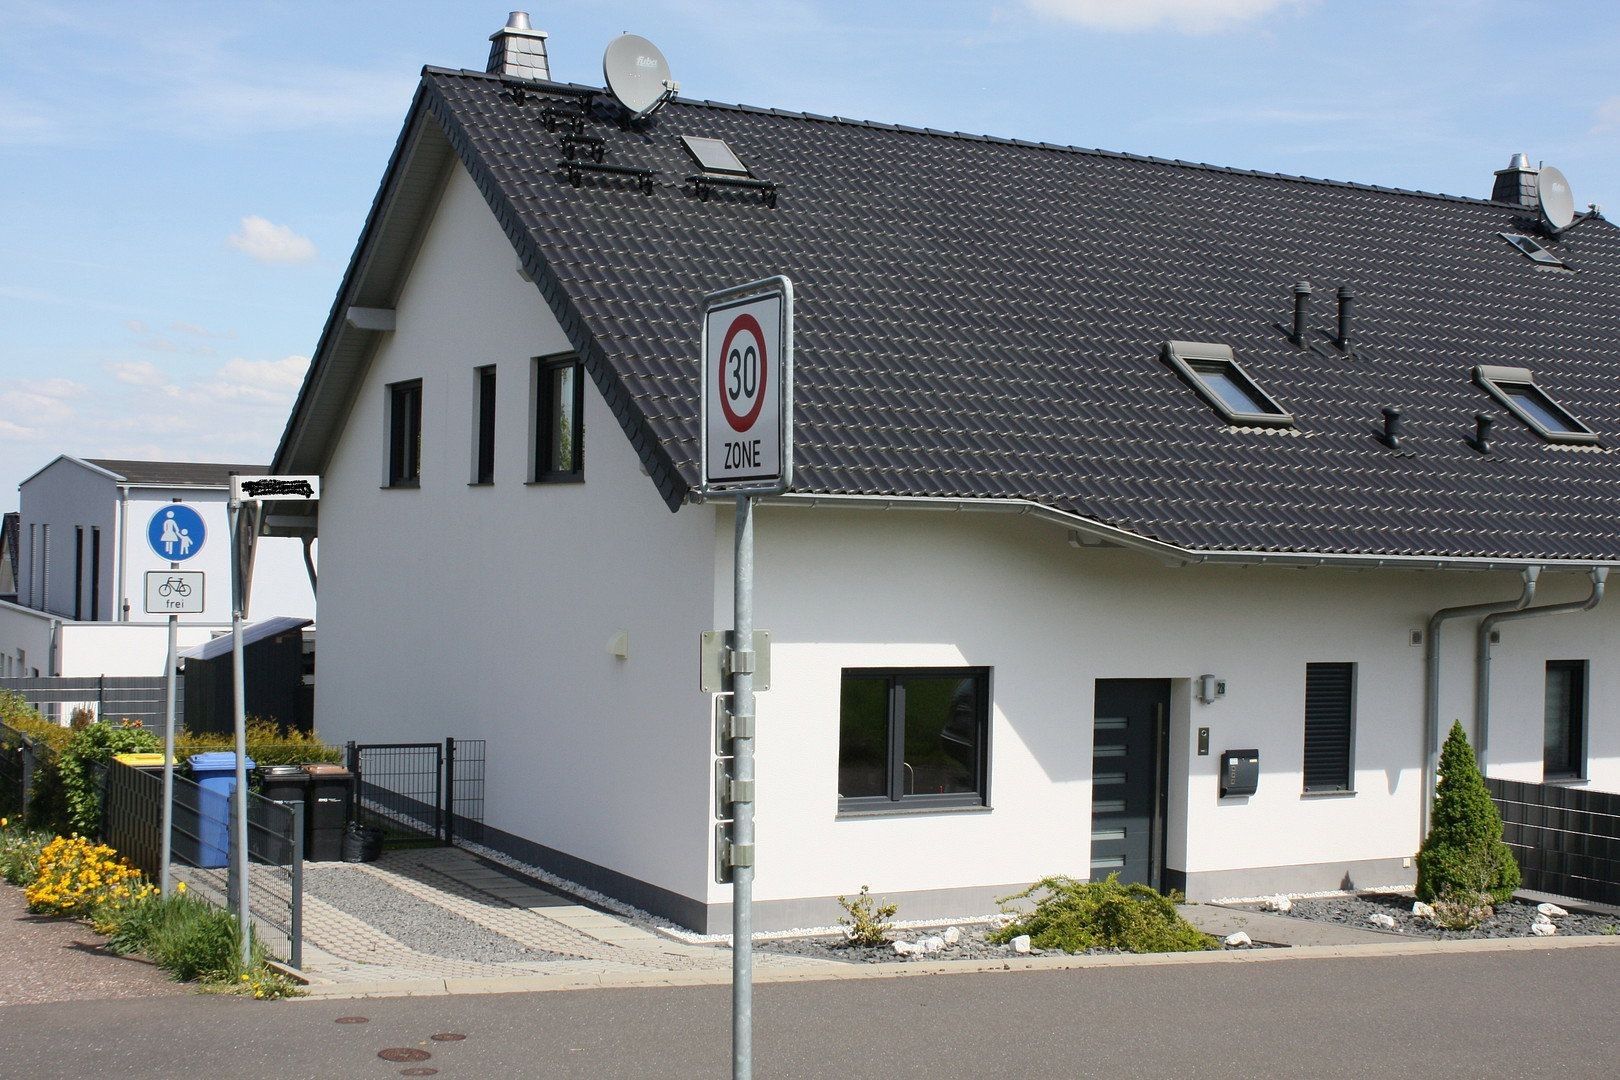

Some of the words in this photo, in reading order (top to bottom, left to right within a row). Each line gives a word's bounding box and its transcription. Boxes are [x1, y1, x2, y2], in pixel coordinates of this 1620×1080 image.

[728, 345, 757, 401] 30
[724, 439, 761, 470] ZONE
[166, 599, 184, 608] frei
